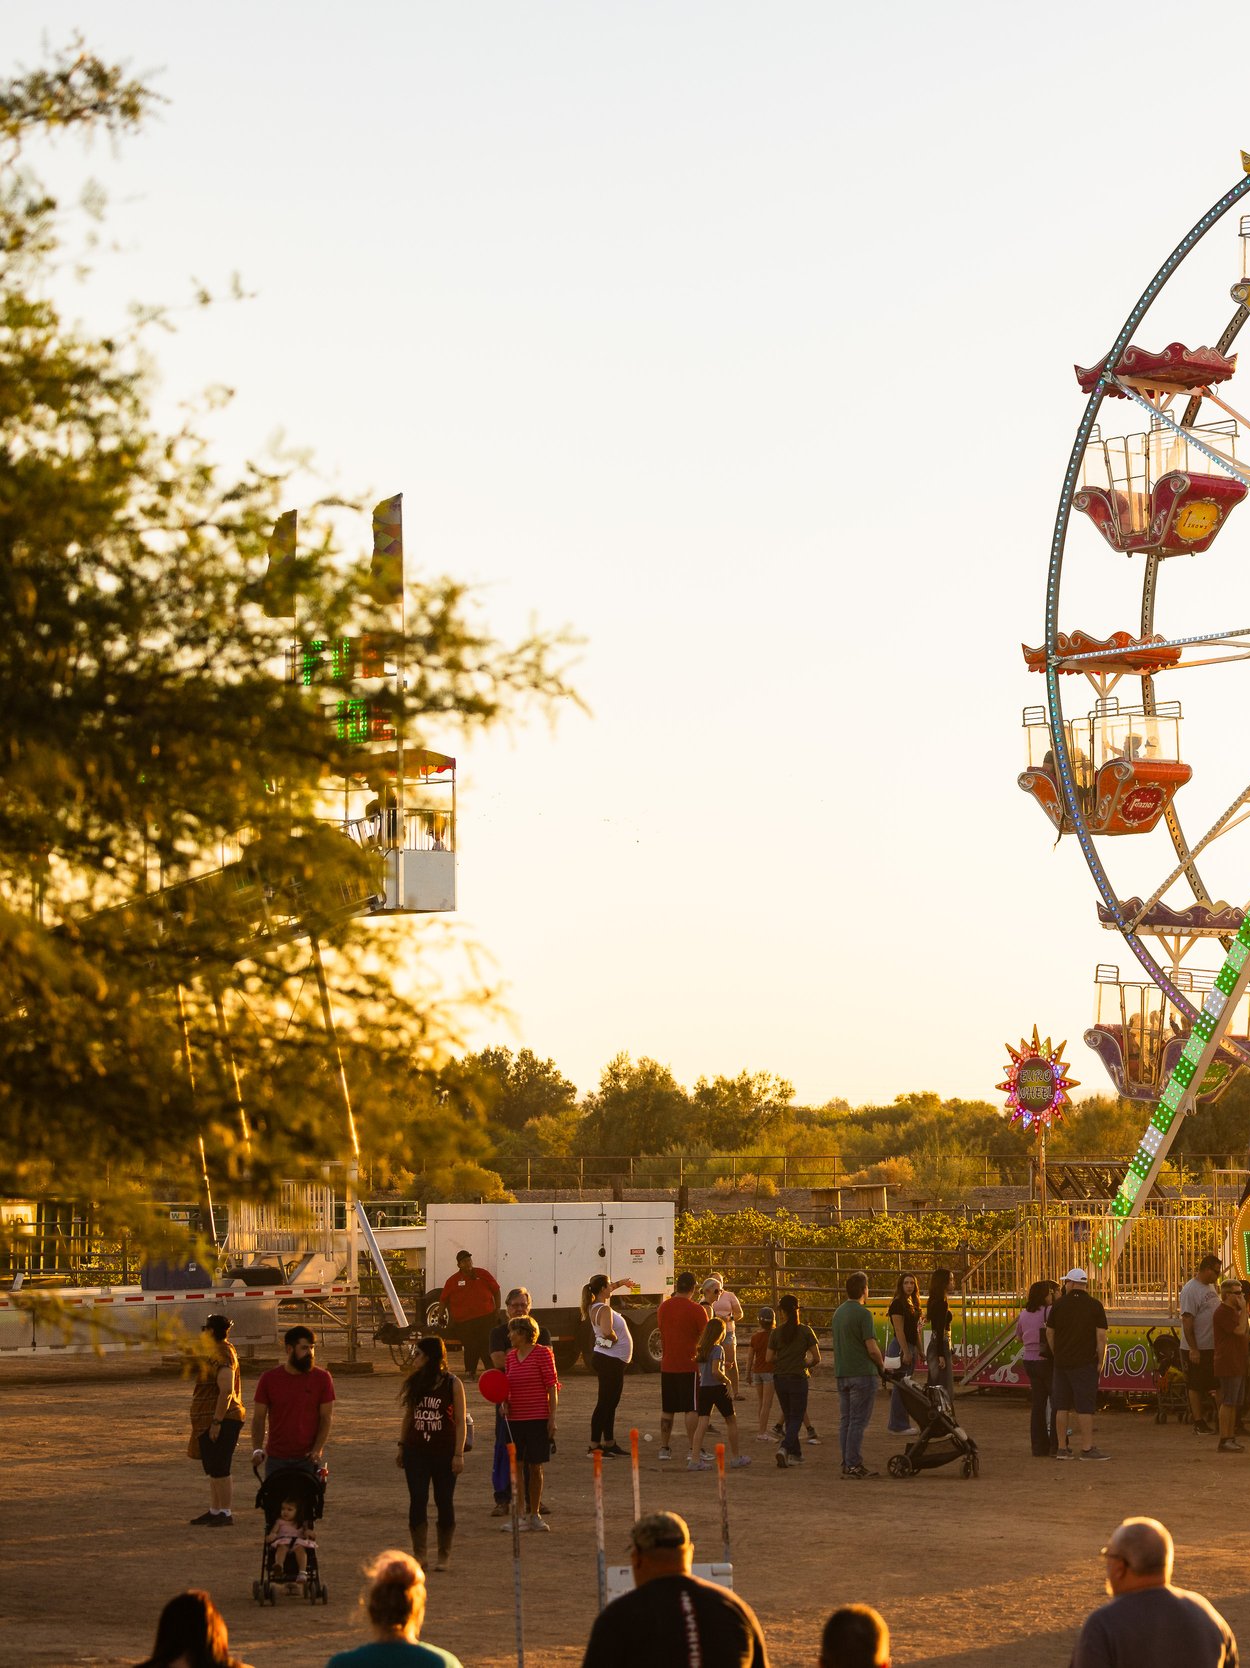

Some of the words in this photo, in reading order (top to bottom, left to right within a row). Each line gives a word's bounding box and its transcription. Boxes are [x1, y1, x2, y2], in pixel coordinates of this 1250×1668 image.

[1020, 1069, 1053, 1083] EURO
[1017, 1085, 1053, 1100] WHEEL
[417, 1396, 442, 1410] ATING
[426, 1420, 442, 1431] TWO
